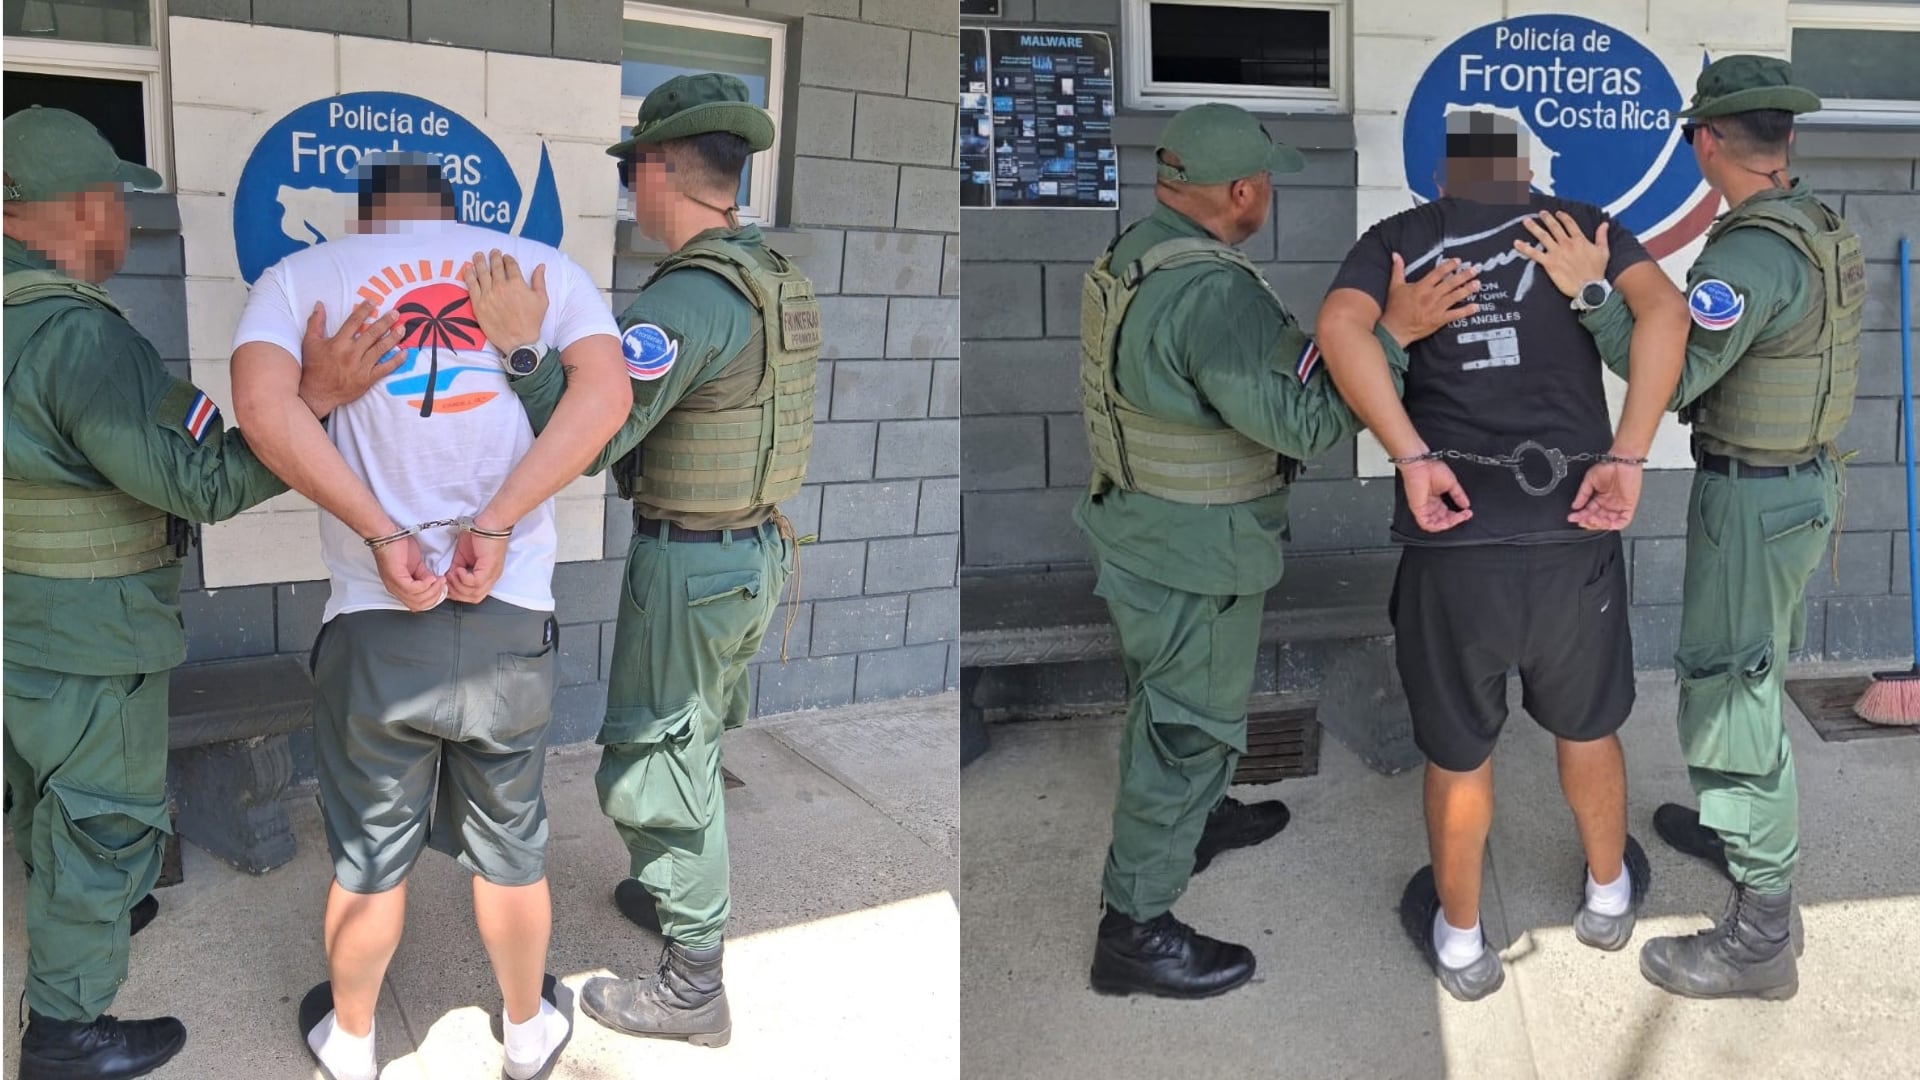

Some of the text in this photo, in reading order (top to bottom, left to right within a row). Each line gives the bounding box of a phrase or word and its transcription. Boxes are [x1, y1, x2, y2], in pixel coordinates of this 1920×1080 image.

[1020, 35, 1083, 48] MALWARE
[1496, 26, 1612, 53] Policía de
[1460, 54, 1642, 96] Fronteras
[329, 102, 450, 137] Policía de
[1534, 98, 1670, 130] Costa Rica
[462, 190, 511, 224] Rica
[1471, 311, 1521, 325] ANGELES
